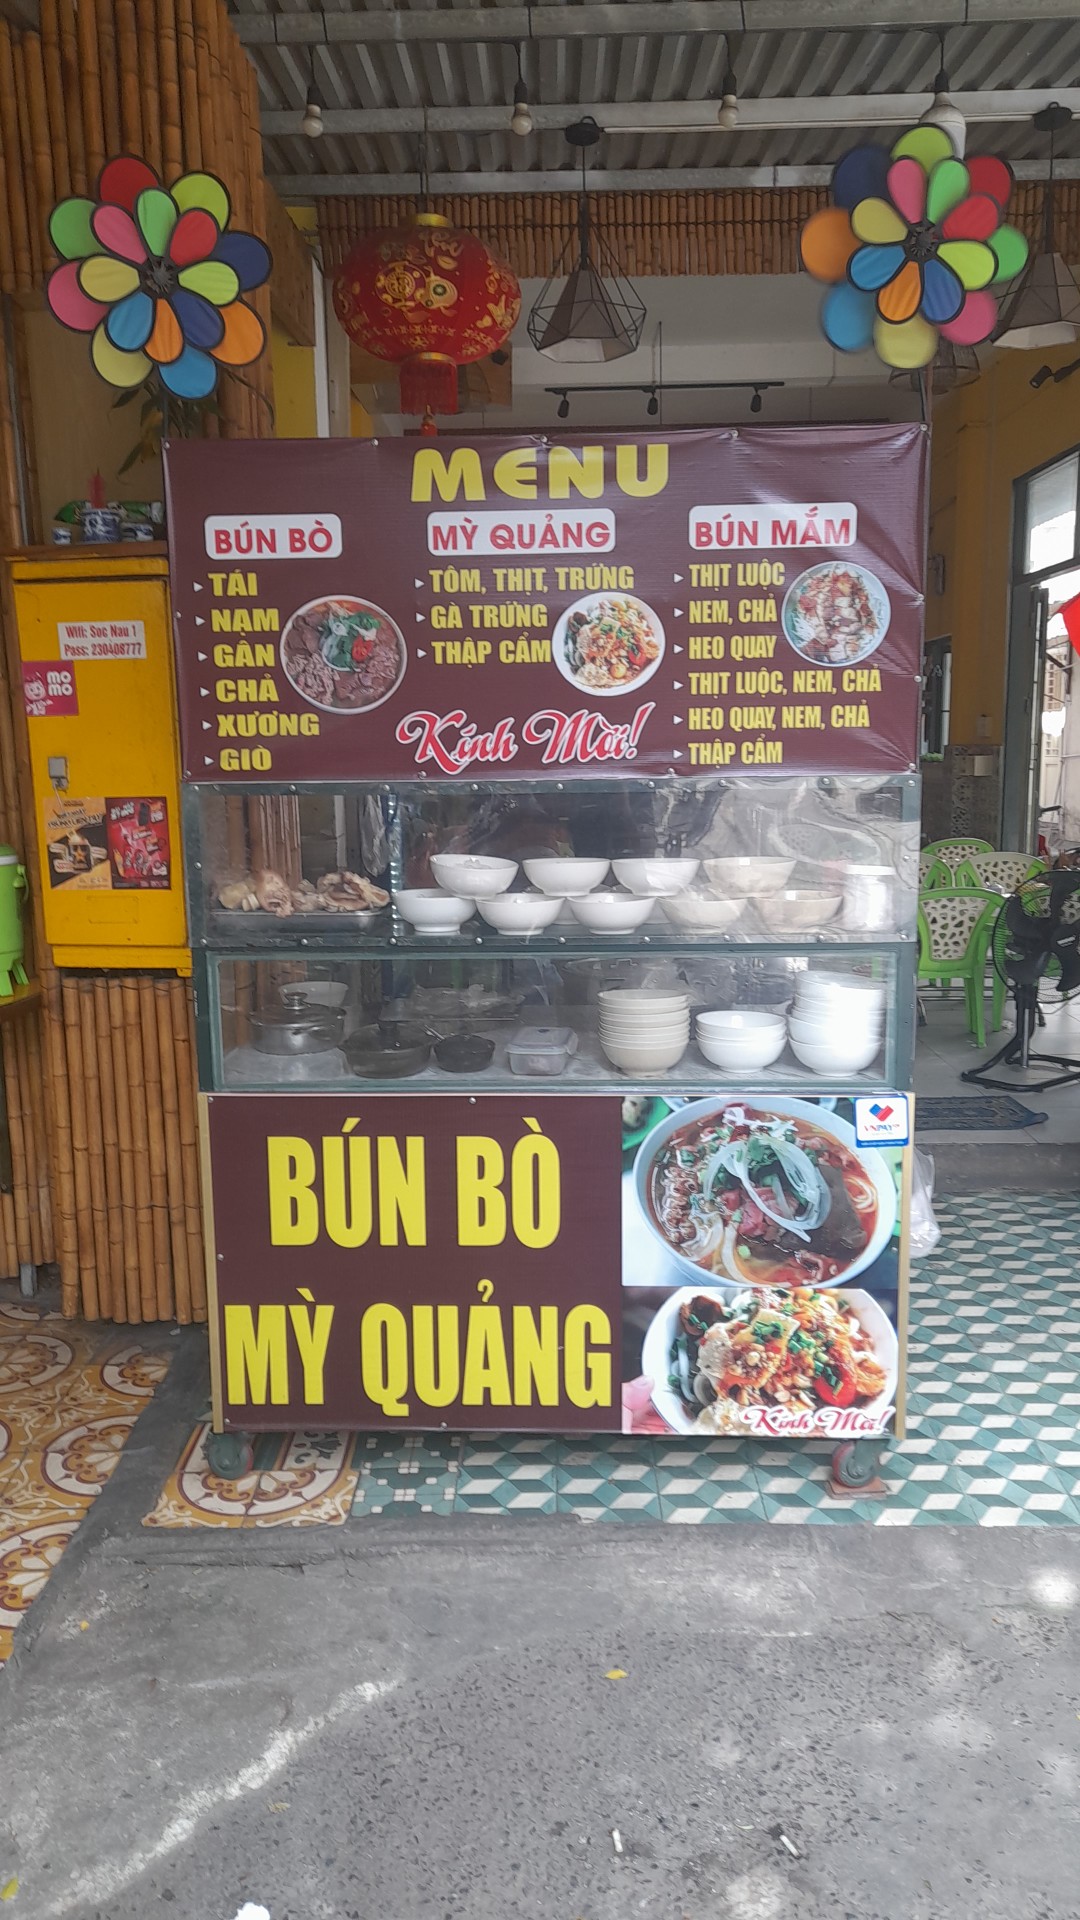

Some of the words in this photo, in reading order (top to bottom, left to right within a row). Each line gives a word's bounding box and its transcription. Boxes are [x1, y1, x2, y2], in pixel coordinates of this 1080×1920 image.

[411, 443, 669, 503] MENU
[213, 521, 277, 554] BÚN
[288, 519, 333, 553] BÒ
[432, 517, 478, 551] MỲ
[490, 513, 610, 551] QUẢNG
[695, 513, 758, 547] BÚN
[771, 506, 850, 546] MẮM
[207, 569, 258, 597] TÁI
[428, 564, 487, 595] TÔM,
[492, 568, 548, 596] THỊT,
[554, 563, 635, 591] TRỨNG
[689, 563, 732, 591] THỊT
[737, 558, 785, 591] LUỘC
[211, 608, 280, 636] NẠM
[430, 602, 463, 629] GÀ
[469, 601, 548, 629] TRỨNG
[688, 599, 733, 626] NEM,
[738, 593, 777, 623] CHẢ
[431, 637, 492, 668] THẬP
[499, 631, 552, 664] CẨM
[688, 636, 725, 660] HEO
[730, 635, 777, 662] QUAY
[215, 673, 280, 703] CHẢ
[688, 671, 731, 699] THỊT
[735, 666, 788, 698] LUỘC,
[793, 670, 837, 695] NEM,
[842, 663, 882, 692] CHẢ
[216, 711, 320, 737] XƯƠNG
[688, 707, 725, 731] HEO
[729, 706, 776, 732] QUAY,
[781, 705, 826, 731] NEM,
[830, 699, 871, 728] CHẢ
[396, 709, 519, 775] Kính
[521, 701, 657, 764] Mời!
[687, 738, 736, 769] THẬP
[741, 733, 783, 765] CẨM
[219, 745, 272, 771] GIÒ
[266, 1117, 427, 1249] BÚN
[456, 1116, 561, 1249] BÒ
[224, 1287, 335, 1405] MỲ
[360, 1279, 612, 1417] QUẢNG
